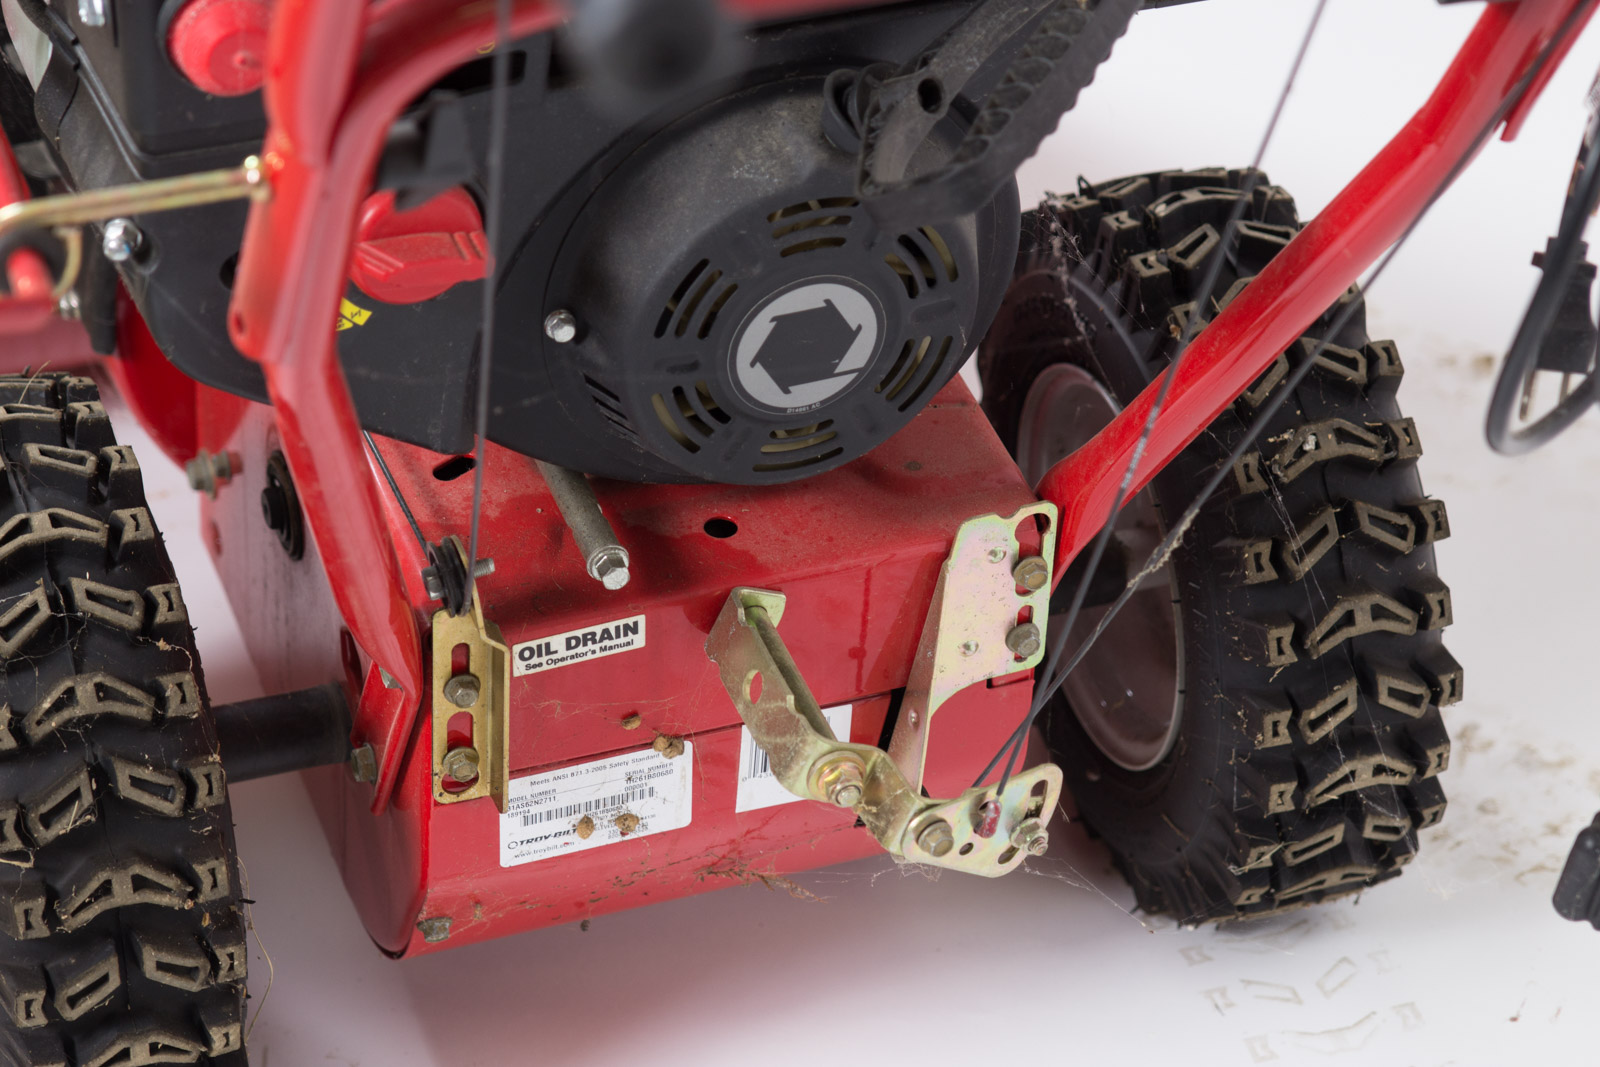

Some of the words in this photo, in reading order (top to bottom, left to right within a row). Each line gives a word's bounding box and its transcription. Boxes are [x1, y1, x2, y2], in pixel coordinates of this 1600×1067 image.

[518, 641, 558, 662] OIL
[565, 620, 639, 651] DRAIN
[525, 662, 543, 671] See
[546, 648, 597, 666] Operator's
[599, 639, 634, 653] Manual
[530, 778, 550, 787] Meets
[552, 773, 569, 782] ANSI
[609, 761, 630, 769] Safety
[631, 753, 660, 764] Standard
[625, 768, 645, 777] SERIAL
[648, 762, 674, 772] NUMBER
[530, 789, 557, 798] NUMBER
[519, 828, 577, 846] TROY-BILT
